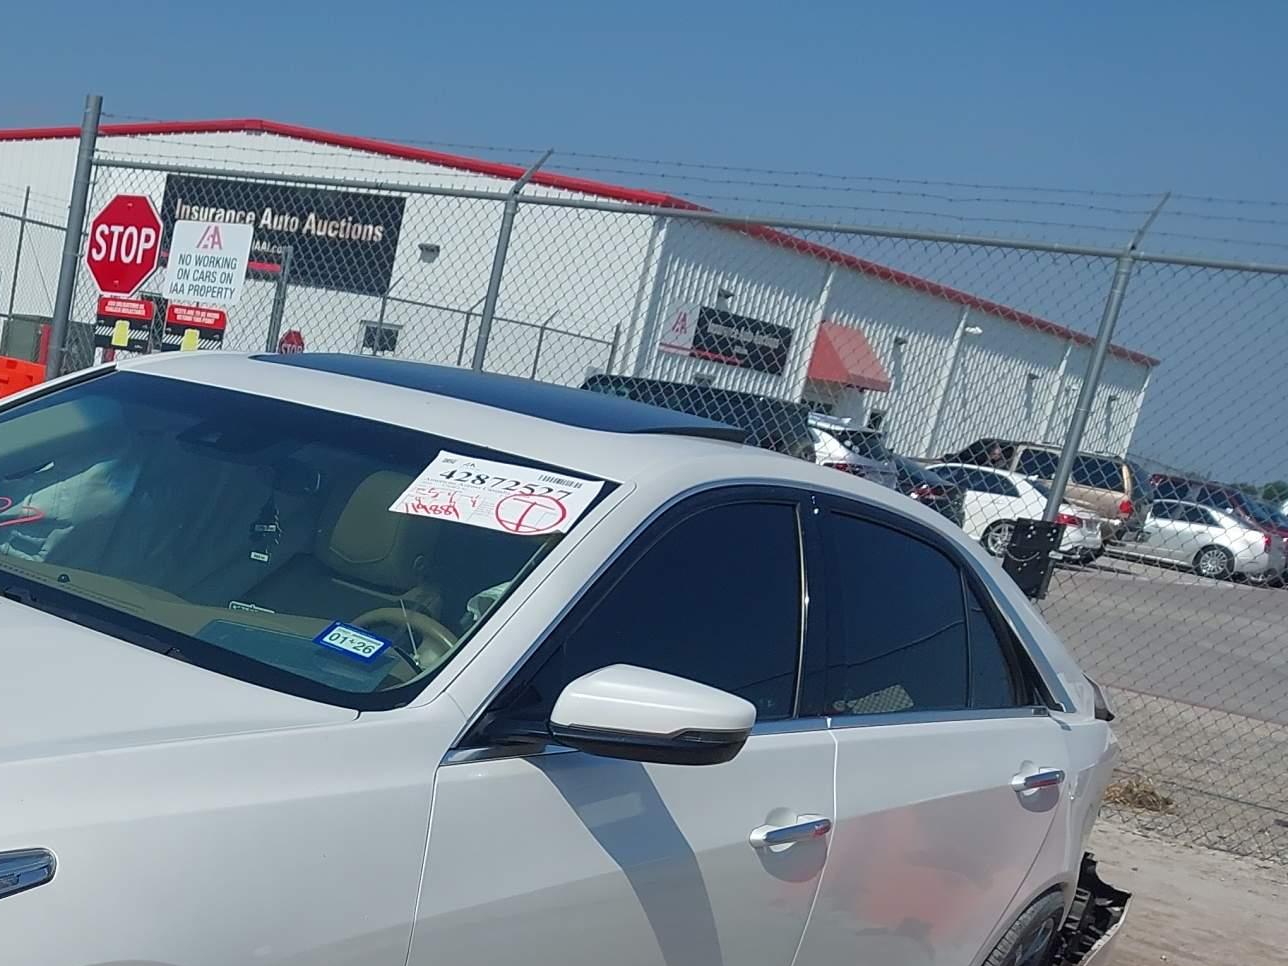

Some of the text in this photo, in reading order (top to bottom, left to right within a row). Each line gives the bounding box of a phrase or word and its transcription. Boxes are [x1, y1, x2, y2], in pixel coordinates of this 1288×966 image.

[175, 198, 385, 242] Insurance Auto Auctions
[91, 223, 156, 264] STOP
[178, 253, 238, 270] NO WORKING
[176, 268, 234, 285] ON CARS ON
[169, 283, 236, 299] IAA PROPERTY
[282, 343, 303, 354] STOP
[439, 468, 574, 501] 42872527
